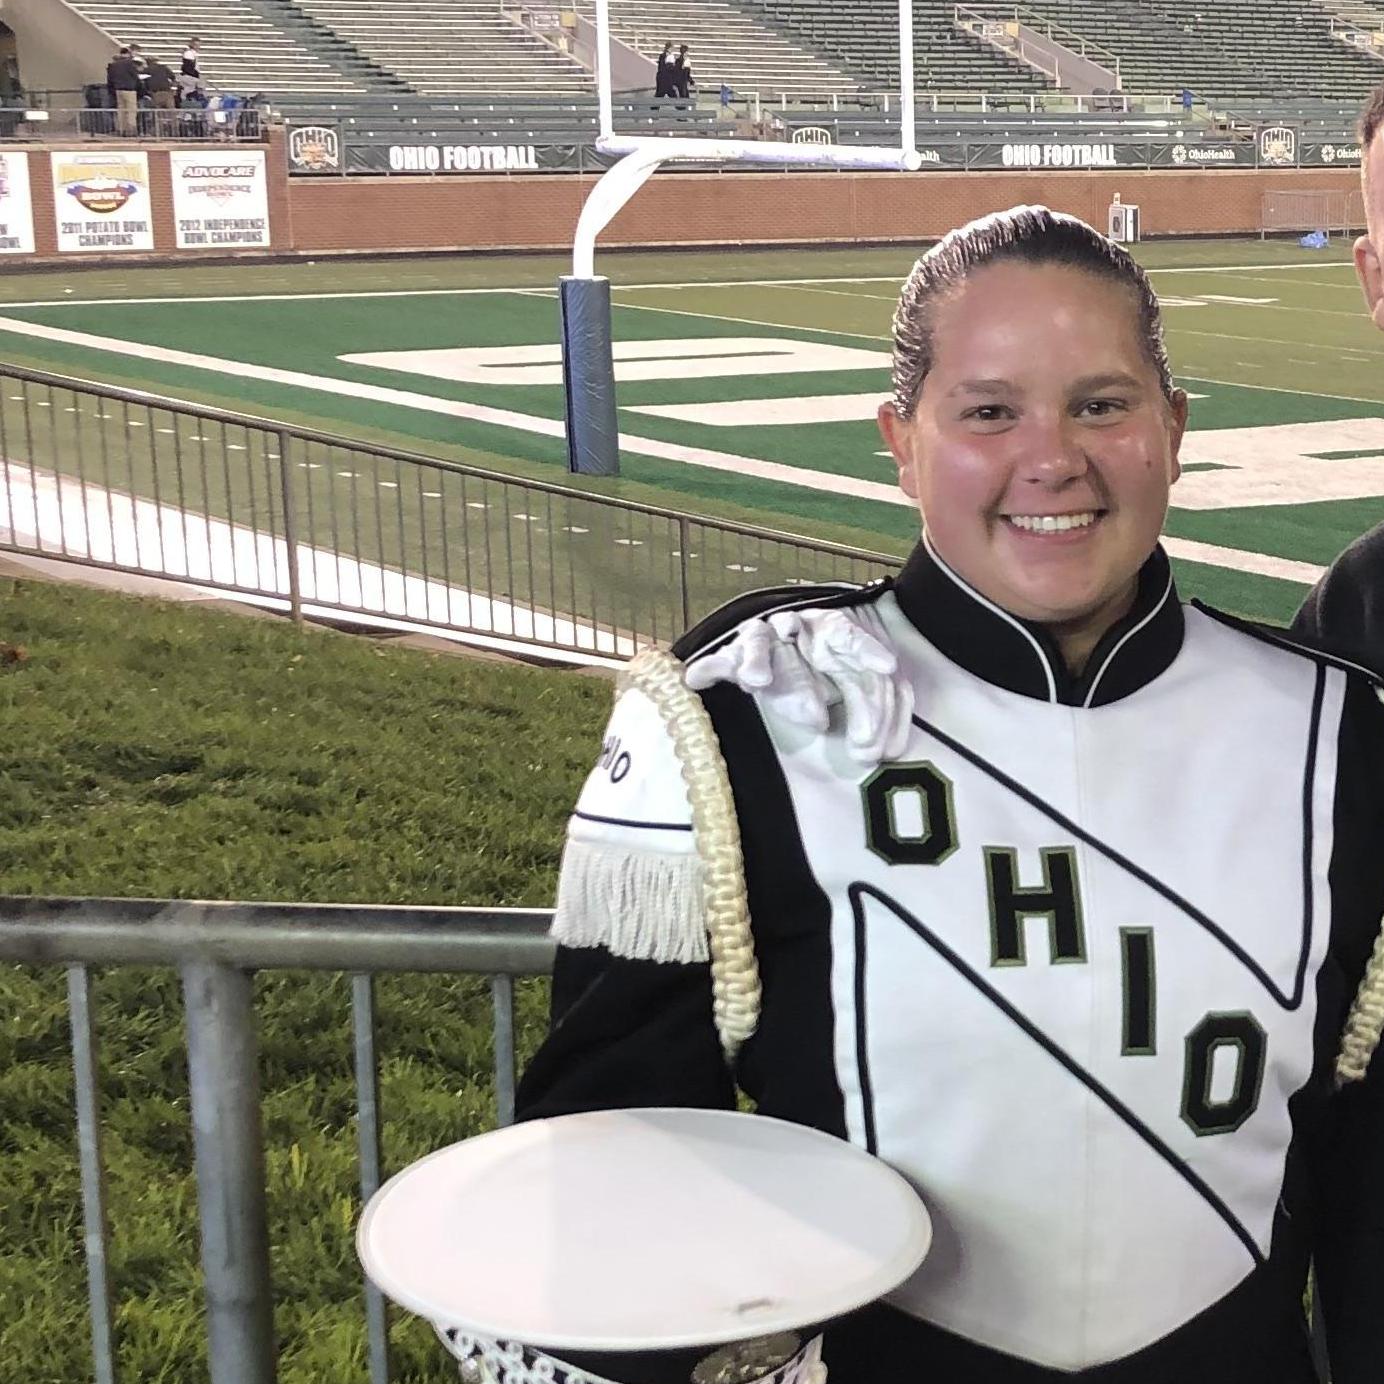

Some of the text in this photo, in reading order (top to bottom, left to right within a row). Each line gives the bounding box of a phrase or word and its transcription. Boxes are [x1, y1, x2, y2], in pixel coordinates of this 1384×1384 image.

[389, 146, 539, 169] OHIO FOOTBALL
[1001, 145, 1117, 167] OHIO FOOTBALL
[1188, 149, 1236, 161] OhioHealth
[182, 165, 257, 178] ADVOCARE
[204, 217, 266, 231] INDEPENDENCE
[78, 233, 134, 247] CHAMPIONS
[211, 231, 264, 244] CHAMPIONS
[859, 759, 1268, 1138] OHIO
